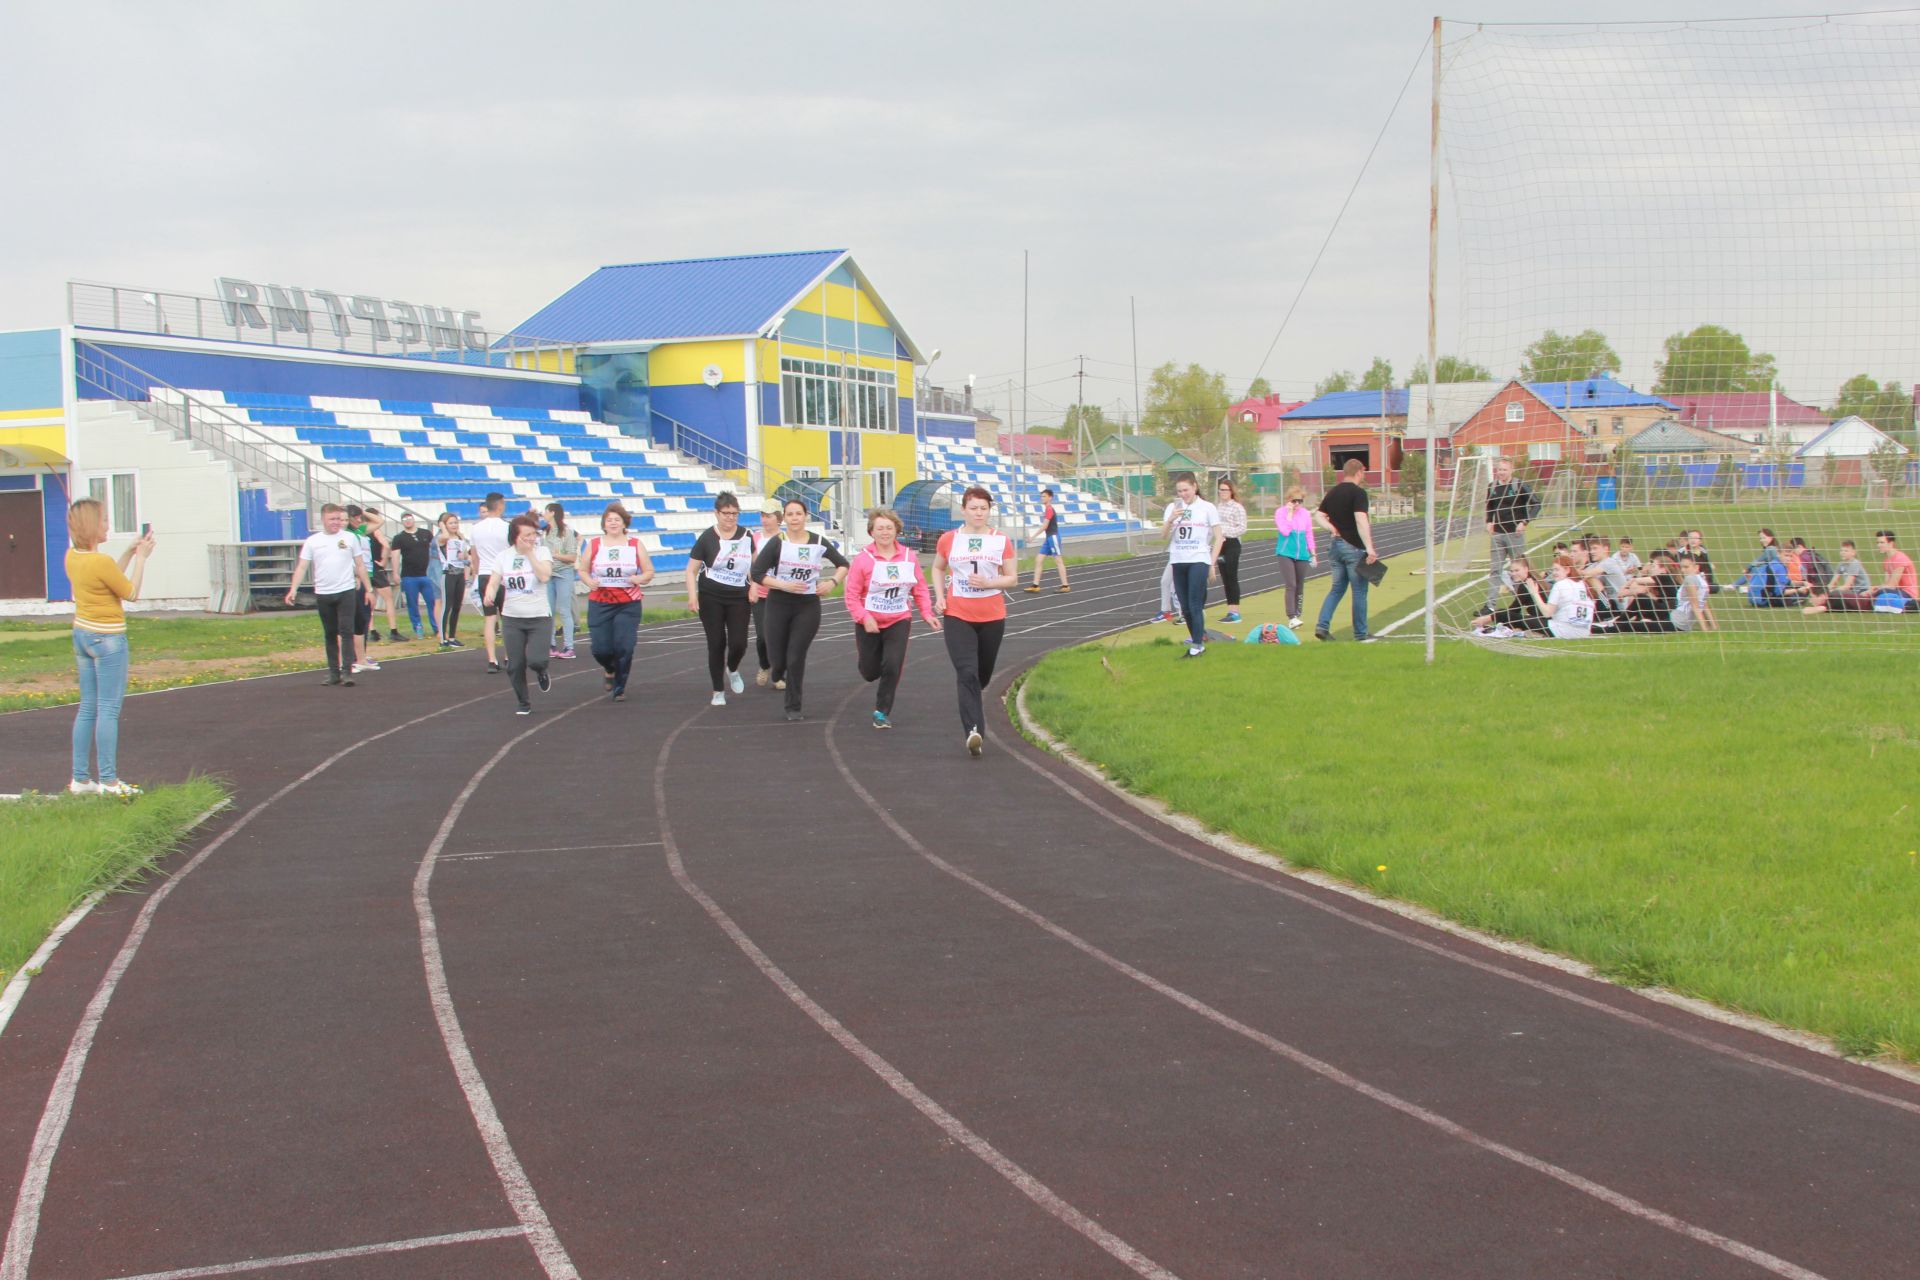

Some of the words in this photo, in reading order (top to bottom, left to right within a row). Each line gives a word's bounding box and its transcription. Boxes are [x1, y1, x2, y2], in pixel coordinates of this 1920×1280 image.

[1179, 527, 1192, 539] 97
[727, 557, 735, 570] 6
[607, 567, 622, 577] 84
[790, 568, 812, 581] 158
[508, 576, 526, 590] 80
[1576, 606, 1588, 618] 64
